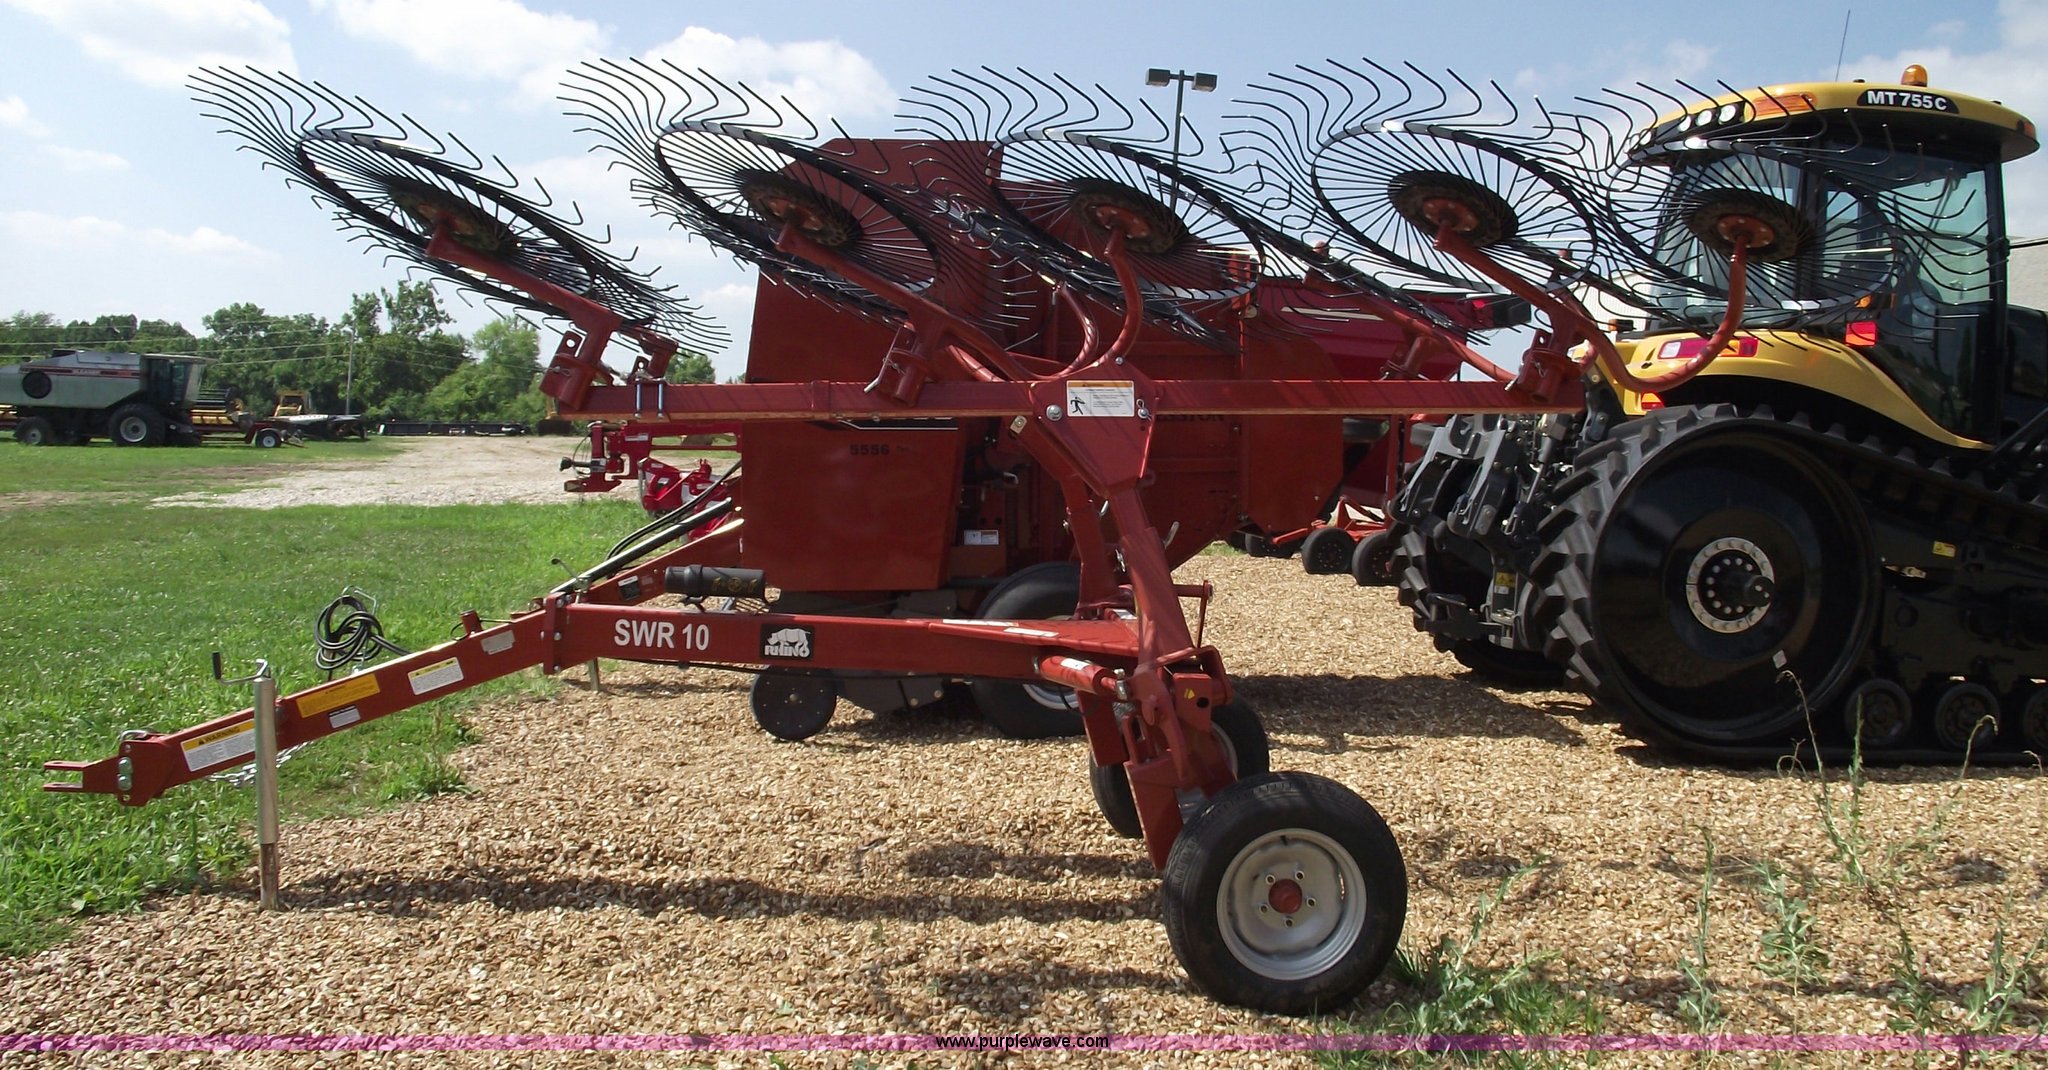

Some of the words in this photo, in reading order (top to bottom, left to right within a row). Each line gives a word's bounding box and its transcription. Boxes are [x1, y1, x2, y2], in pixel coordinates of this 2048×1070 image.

[849, 444, 890, 456] 5556
[614, 618, 674, 649] SWR
[682, 623, 710, 651] 10
[204, 726, 241, 743] WARNING
